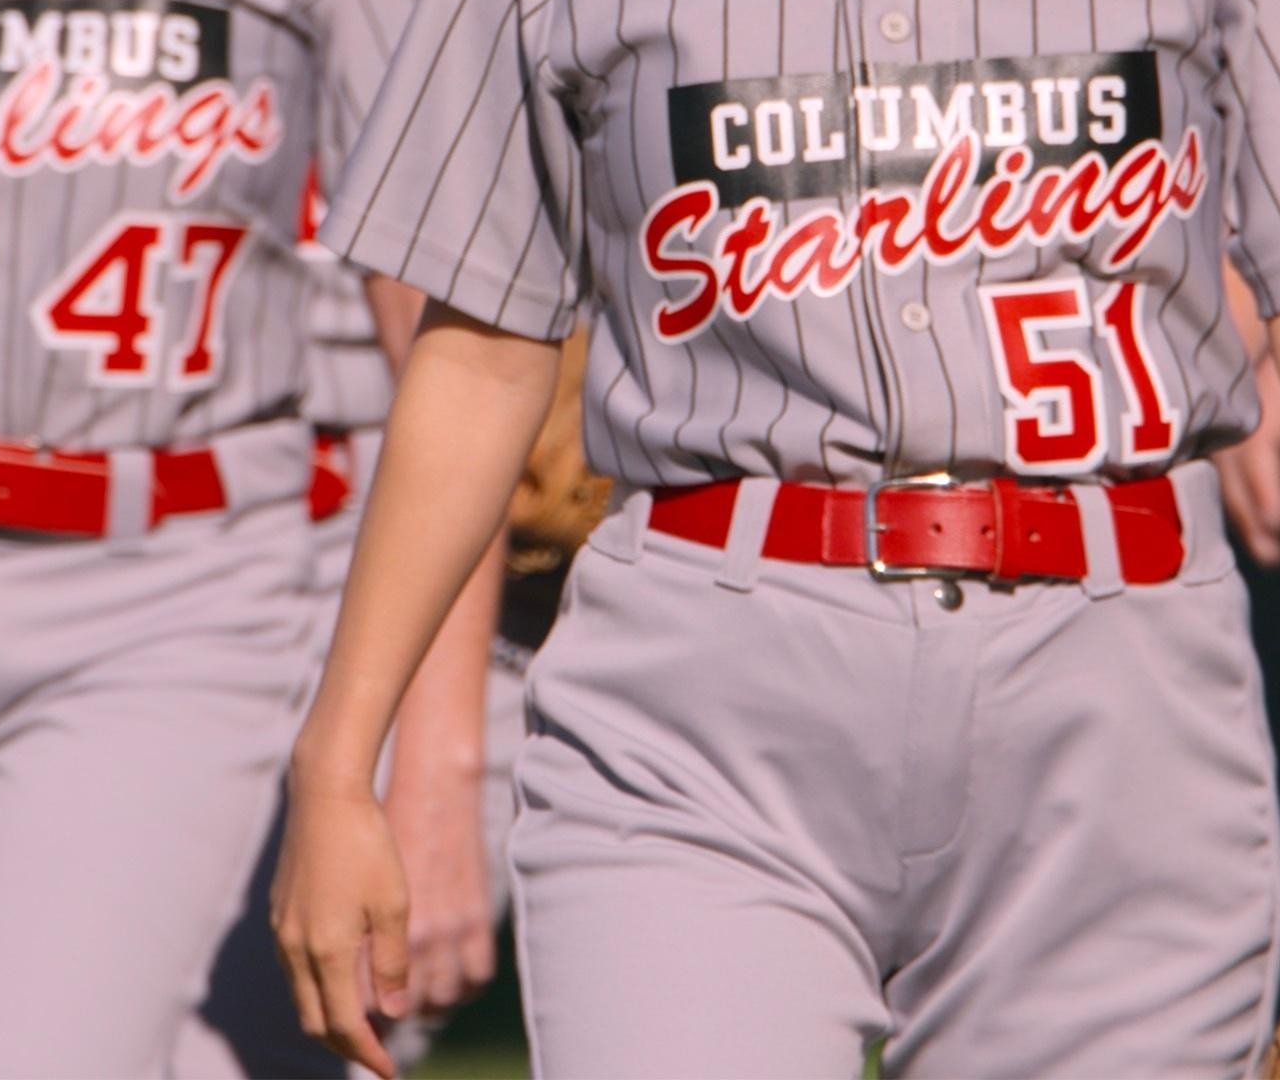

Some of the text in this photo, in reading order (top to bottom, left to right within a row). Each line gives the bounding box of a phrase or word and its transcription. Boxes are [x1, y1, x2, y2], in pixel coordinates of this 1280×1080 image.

[711, 76, 1128, 172] COLUMBUS
[31, 211, 255, 392] 47
[640, 126, 1208, 346] Starlings
[978, 275, 1183, 476] 51
